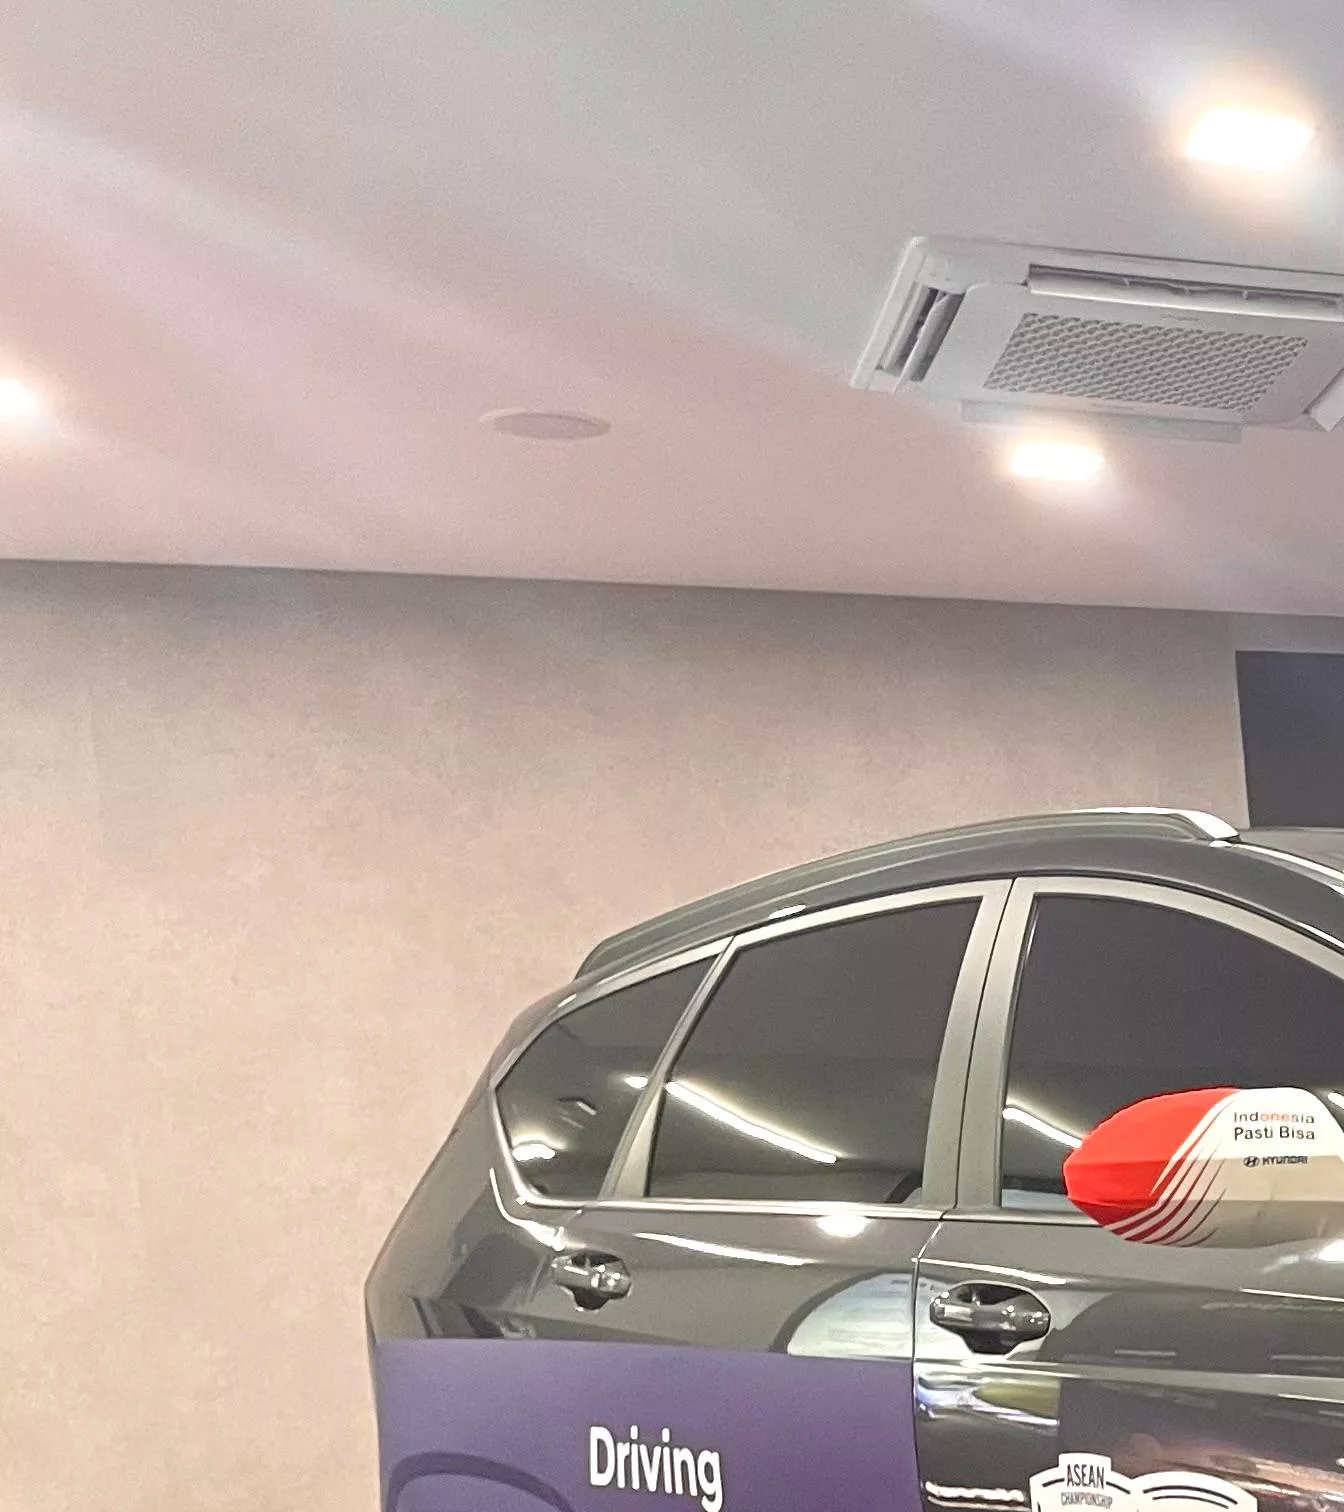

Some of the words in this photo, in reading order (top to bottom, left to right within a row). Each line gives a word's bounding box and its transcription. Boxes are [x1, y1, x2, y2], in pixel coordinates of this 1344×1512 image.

[1233, 1111, 1315, 1124] Indonesia
[1233, 1126, 1274, 1141] Pasti
[1279, 1125, 1315, 1140] Bisa
[1262, 1155, 1308, 1166] HYUNDAI
[1066, 1464, 1105, 1490] ASEAN
